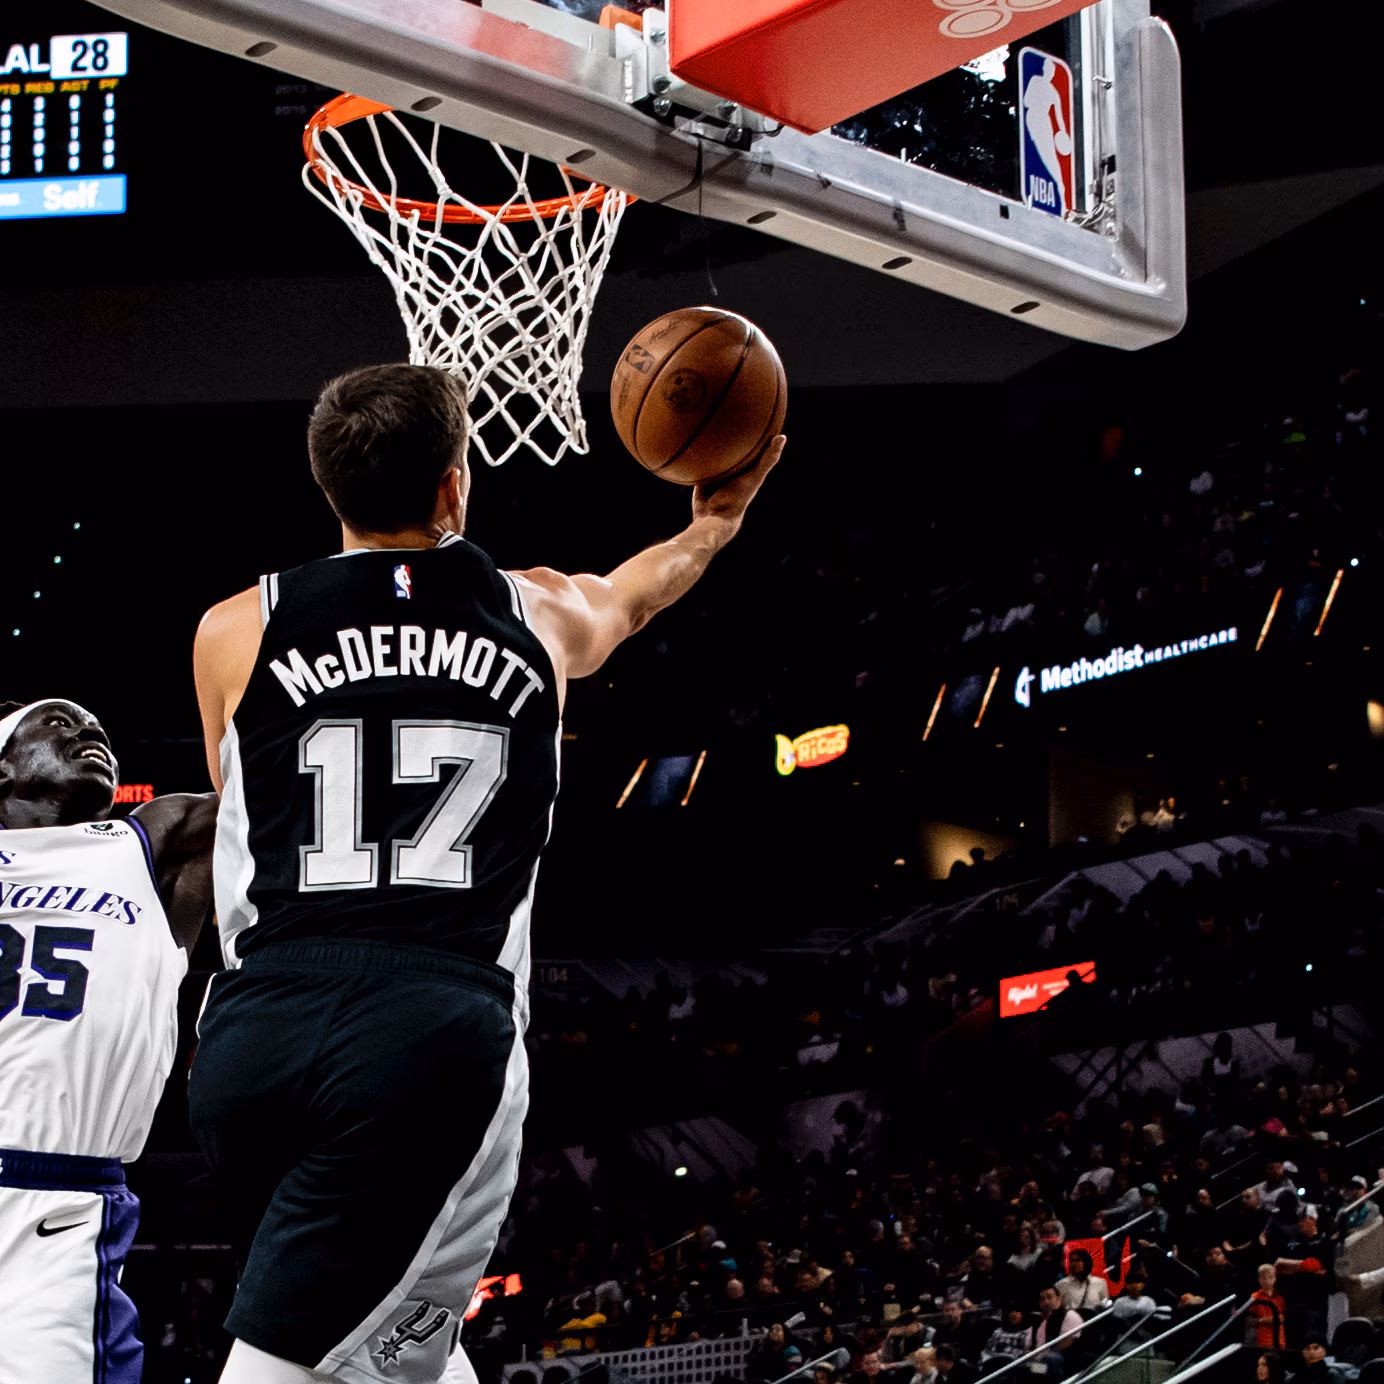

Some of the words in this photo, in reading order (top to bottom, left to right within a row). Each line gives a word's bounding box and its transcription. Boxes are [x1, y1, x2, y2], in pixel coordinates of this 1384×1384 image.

[71, 39, 109, 72] 28
[43, 182, 99, 210] Self
[1030, 174, 1055, 207] NBA
[269, 625, 545, 718] McDERMOTT
[1040, 644, 1145, 693] Methodist
[1145, 627, 1238, 663] HEALTHCARE
[114, 784, 154, 803] ORTS
[298, 718, 510, 892] 17
